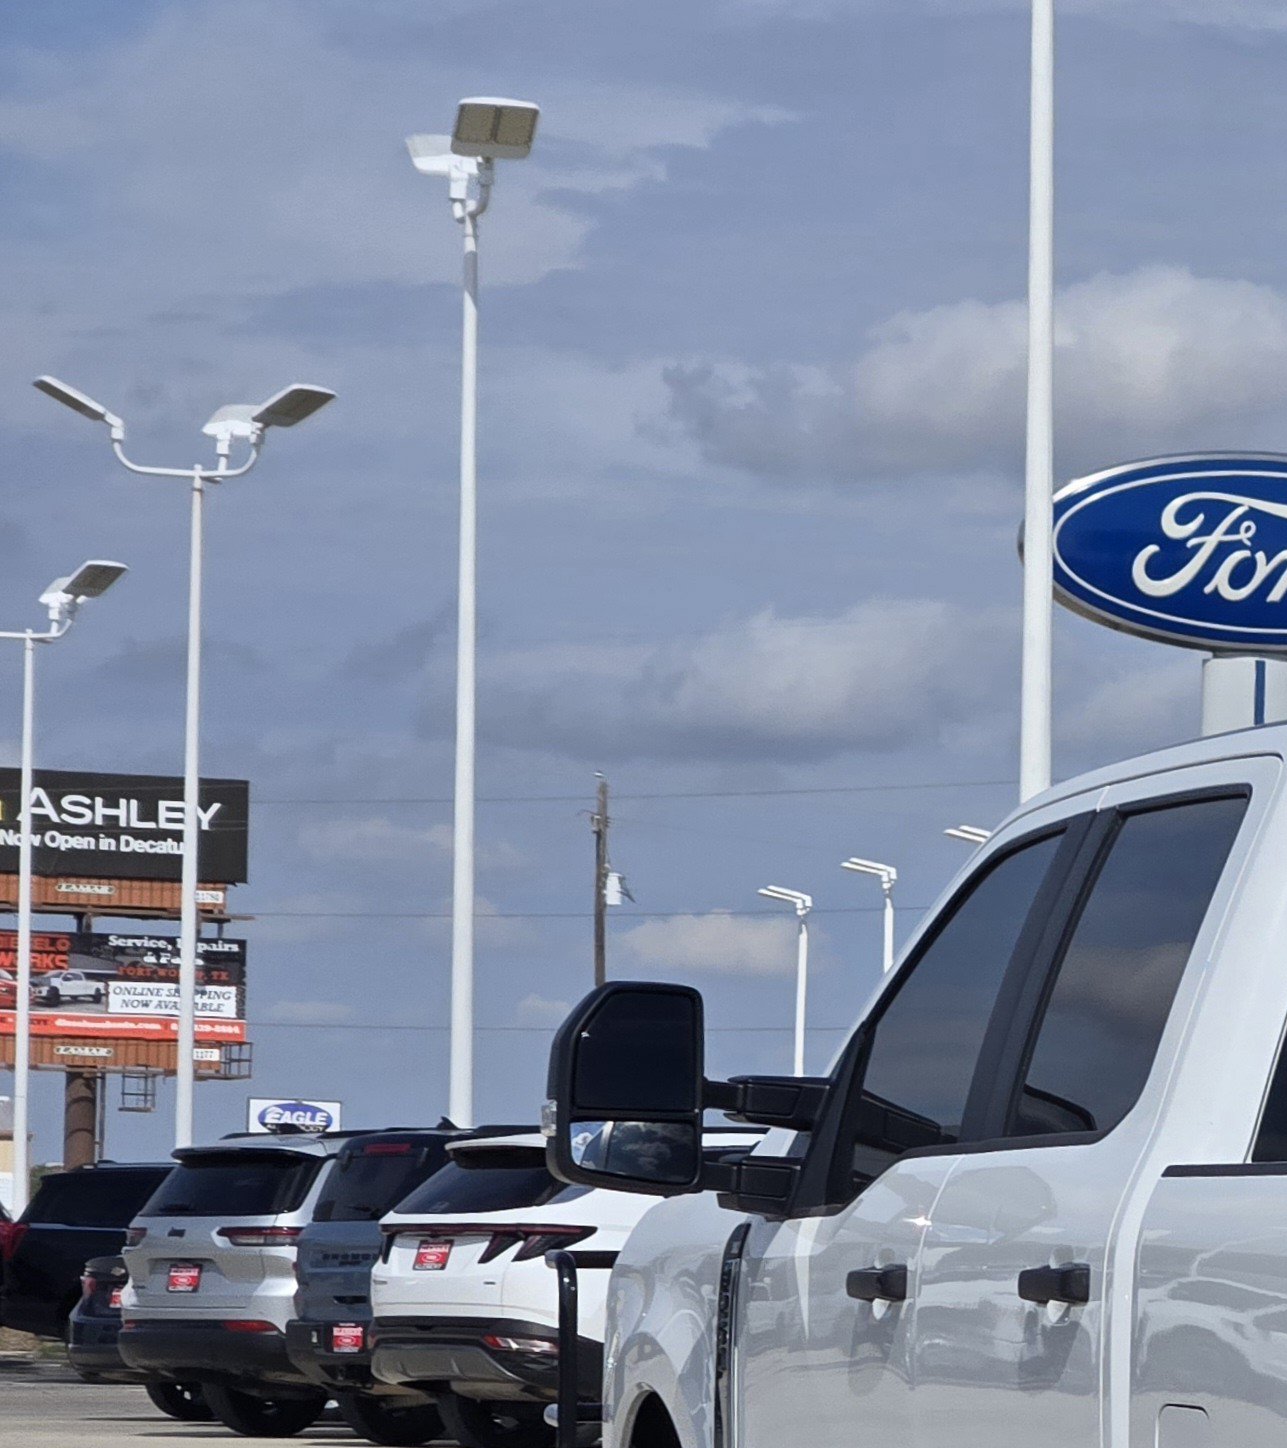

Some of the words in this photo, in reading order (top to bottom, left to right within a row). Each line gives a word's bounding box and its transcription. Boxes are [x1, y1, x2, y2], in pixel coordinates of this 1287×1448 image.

[16, 786, 222, 831] ASHLEY
[44, 830, 95, 851] Open
[99, 834, 116, 851] in
[120, 836, 185, 854] Decatu
[108, 935, 172, 950] Service,
[176, 938, 239, 952] pairs
[0, 951, 69, 970] WRKS
[113, 986, 162, 997] ONLINE
[121, 999, 152, 1009] NOW
[264, 1106, 328, 1126] EAGLE
